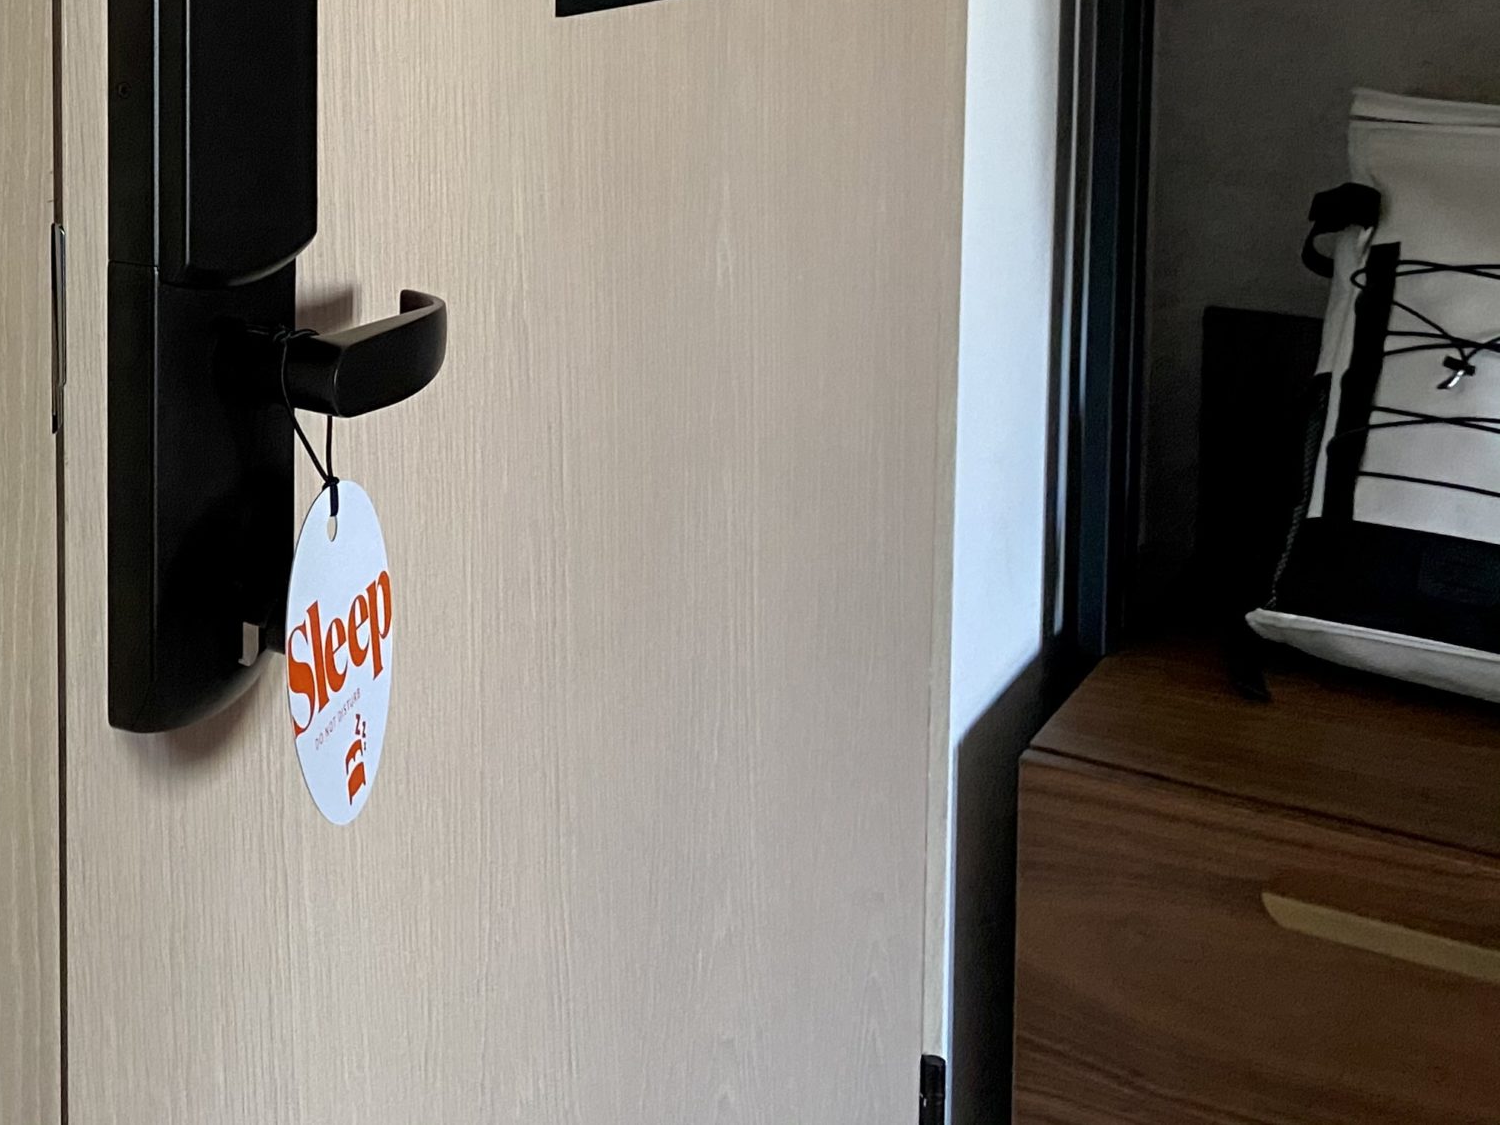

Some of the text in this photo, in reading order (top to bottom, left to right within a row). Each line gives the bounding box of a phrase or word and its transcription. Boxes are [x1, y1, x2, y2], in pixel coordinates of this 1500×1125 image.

[288, 570, 393, 739] Sleep
[315, 687, 361, 751] DO NOT DISTURB
